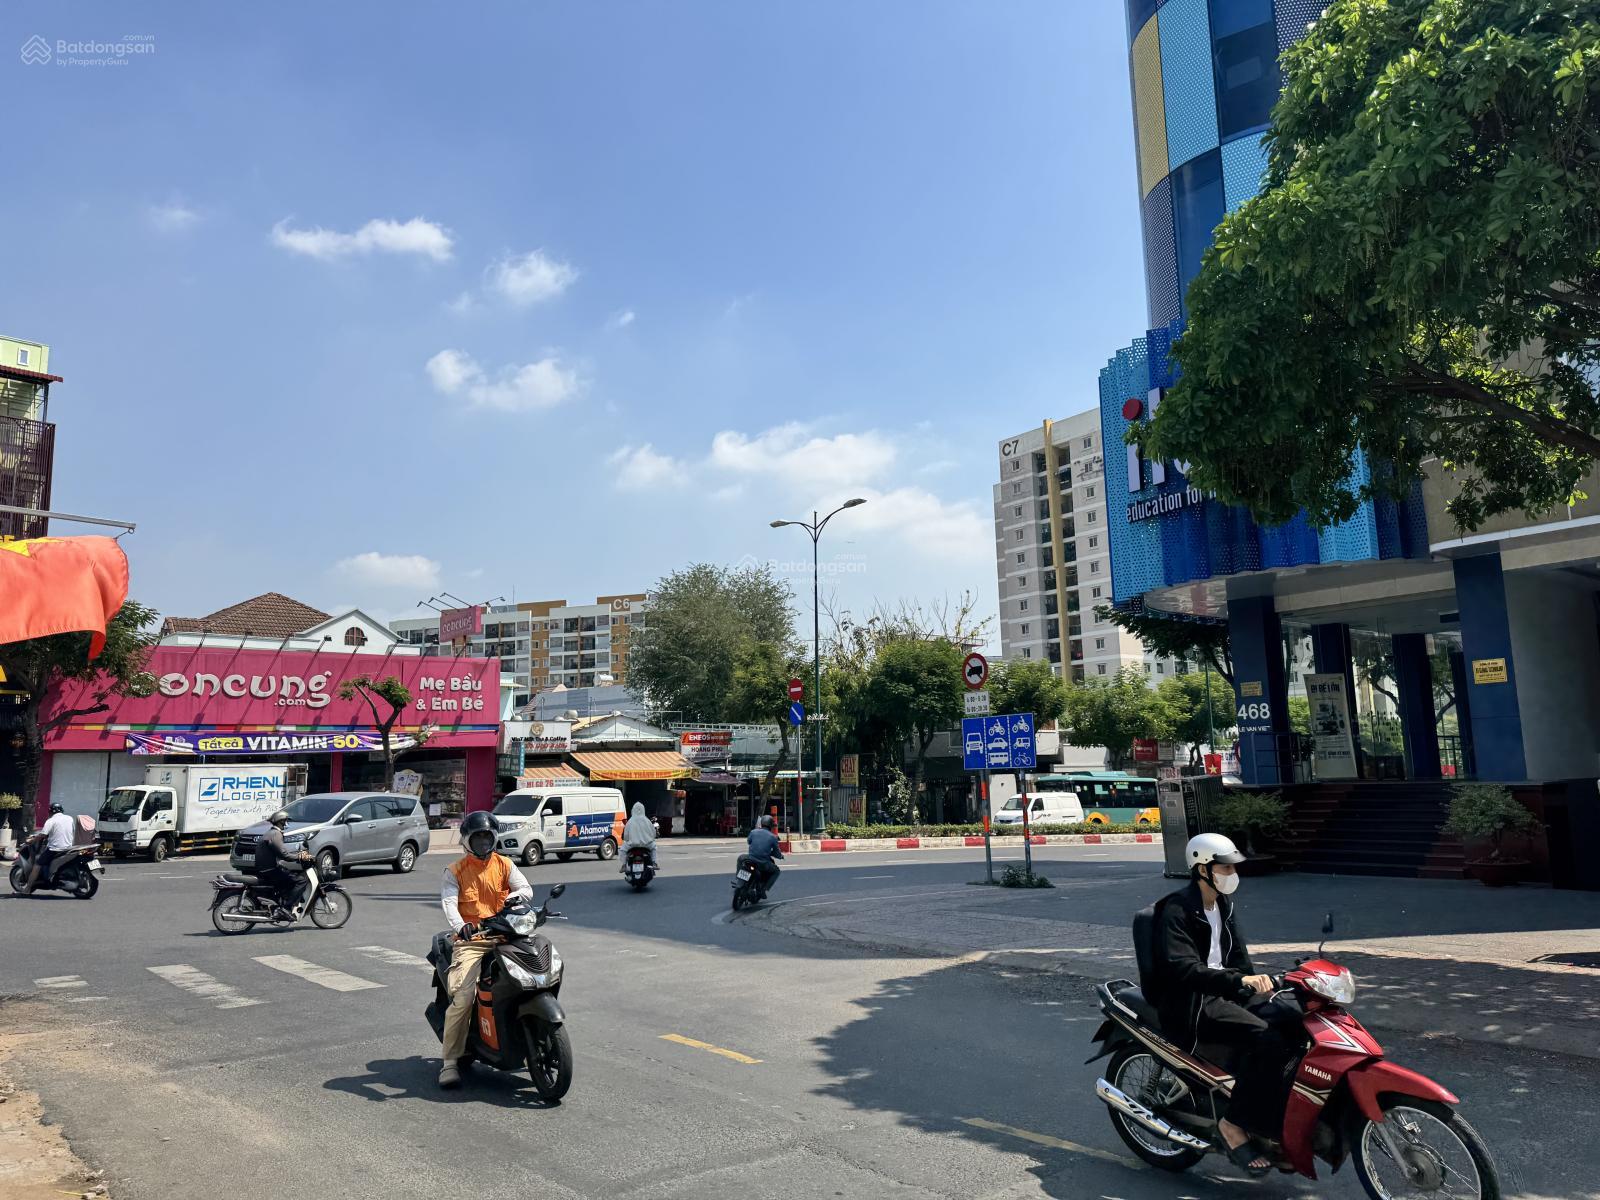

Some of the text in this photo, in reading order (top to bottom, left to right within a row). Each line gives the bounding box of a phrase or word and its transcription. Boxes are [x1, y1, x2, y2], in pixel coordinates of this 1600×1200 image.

[1002, 439, 1019, 457] C7
[1126, 491, 1182, 523] education
[613, 598, 630, 610] C6
[419, 672, 482, 694] Mẹ Bầu
[416, 694, 484, 711] & Em Bé
[1237, 702, 1270, 720] 468
[203, 737, 222, 749] Tất
[247, 737, 327, 750] VITAMIN
[205, 806, 240, 818] Together
[243, 805, 262, 813] with
[1304, 1064, 1332, 1081] YAMAHA
